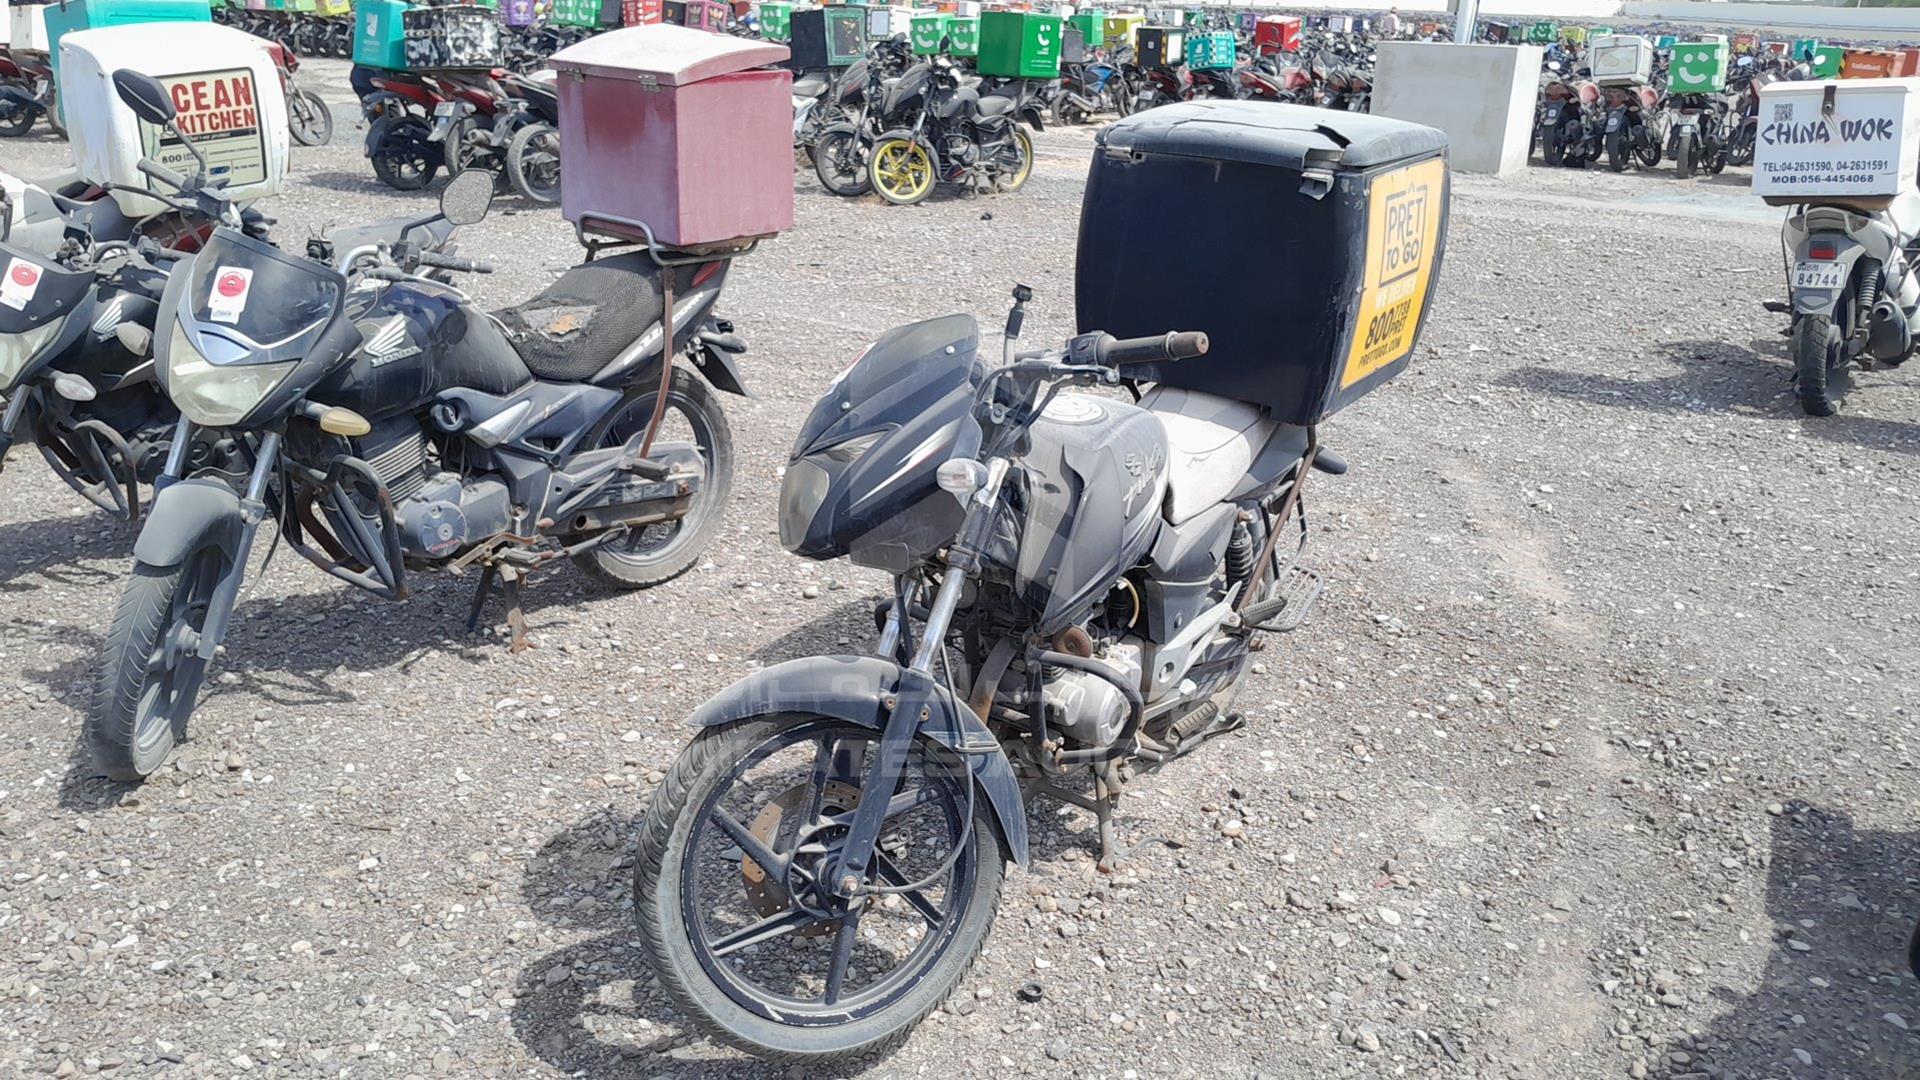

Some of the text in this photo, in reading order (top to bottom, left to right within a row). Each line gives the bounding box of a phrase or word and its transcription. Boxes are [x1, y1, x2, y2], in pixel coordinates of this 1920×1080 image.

[171, 76, 252, 113] CEAN
[176, 108, 257, 134] KITCHEN
[1761, 118, 1894, 146] CHINA WOK
[1771, 174, 1875, 184] MOB:056-4454068
[1836, 160, 1889, 171] 04-2631591
[1387, 198, 1424, 246] PRET
[1387, 240, 1421, 272] TO GO
[1797, 272, 1838, 287] 84744
[1365, 306, 1395, 350] 800
